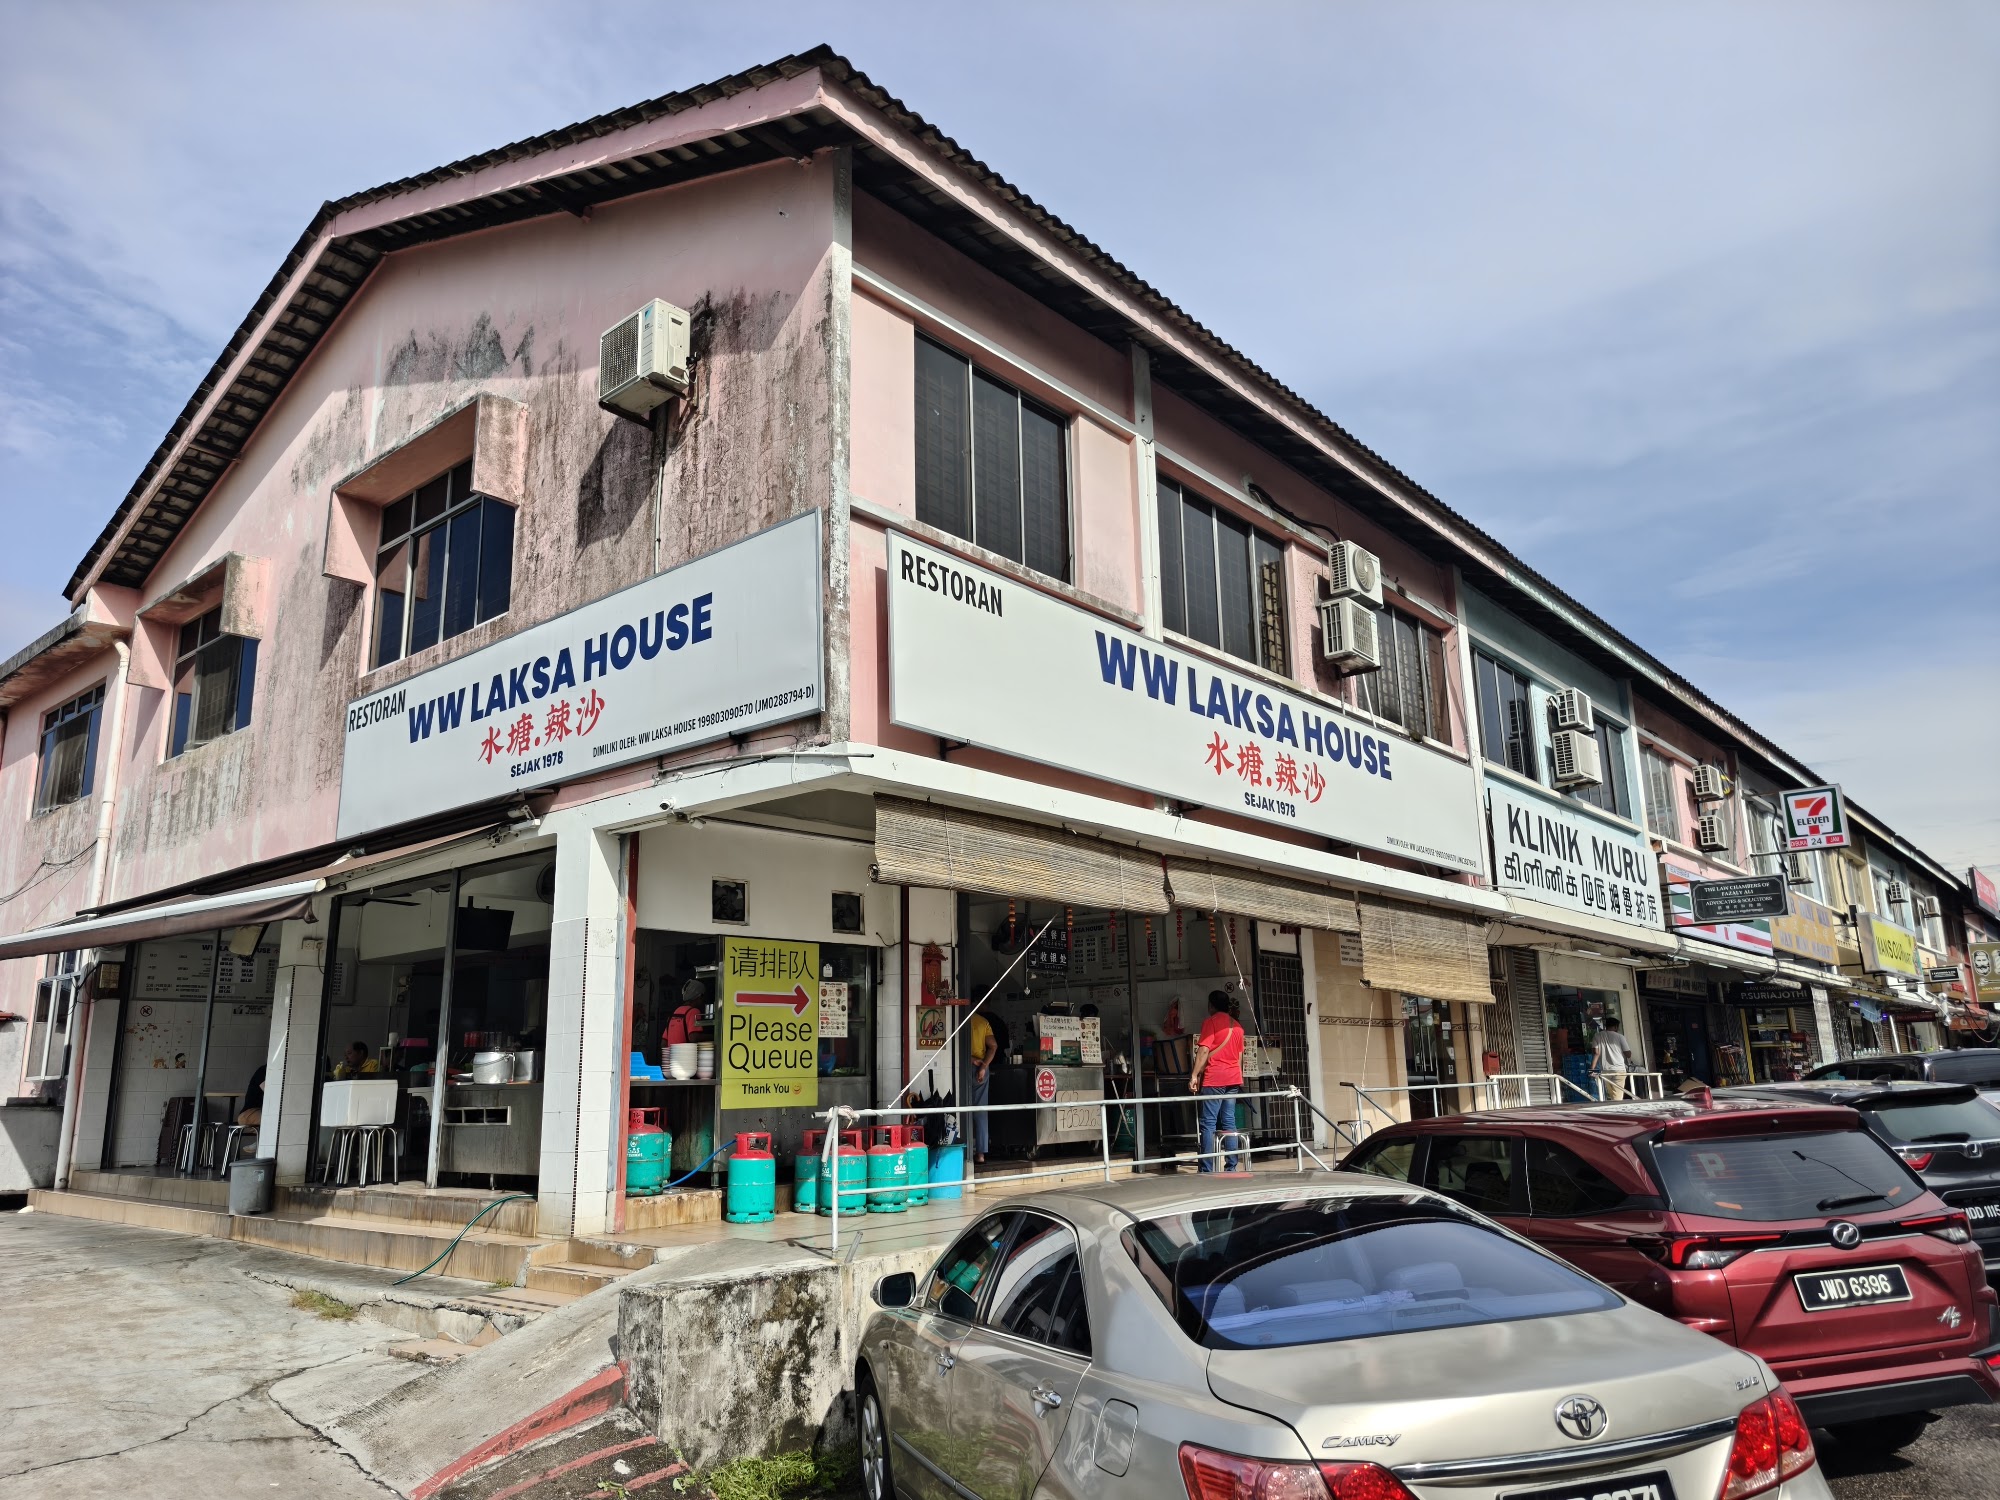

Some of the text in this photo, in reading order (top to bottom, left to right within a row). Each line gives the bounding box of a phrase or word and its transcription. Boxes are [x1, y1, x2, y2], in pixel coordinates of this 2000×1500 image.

[900, 549, 1003, 617] RESTORAN
[408, 592, 713, 743] WW LAKSA HOUSE
[348, 689, 406, 732] RESTORAN
[1095, 630, 1391, 780] WW LAKSA HOUSE
[592, 741, 617, 758] DIMILIKI
[619, 736, 637, 750] OLEH:
[638, 731, 650, 745] WW
[650, 725, 672, 741] LAKSA
[673, 718, 696, 736] HOUSE
[697, 702, 753, 728] 199803090570
[510, 750, 564, 777] SEJAK 1978
[1244, 792, 1295, 818] SEJAK 1978
[1794, 796, 1827, 836] 7
[1507, 803, 1647, 887] KLINIK MURU
[1810, 837, 1822, 846] 24
[1706, 898, 1737, 906] ADVOCATES
[730, 946, 814, 980] 请排队
[1040, 952, 1067, 964] 收银处
[1740, 990, 1807, 1000] P.SURIAJOTHI
[730, 1014, 812, 1042] Please
[728, 1042, 813, 1073] Queue
[742, 1083, 790, 1095] Thank You
[1696, 1153, 1726, 1178] P
[1817, 1273, 1892, 1301] JWD 6396
[1322, 1434, 1402, 1448] CAMRY
